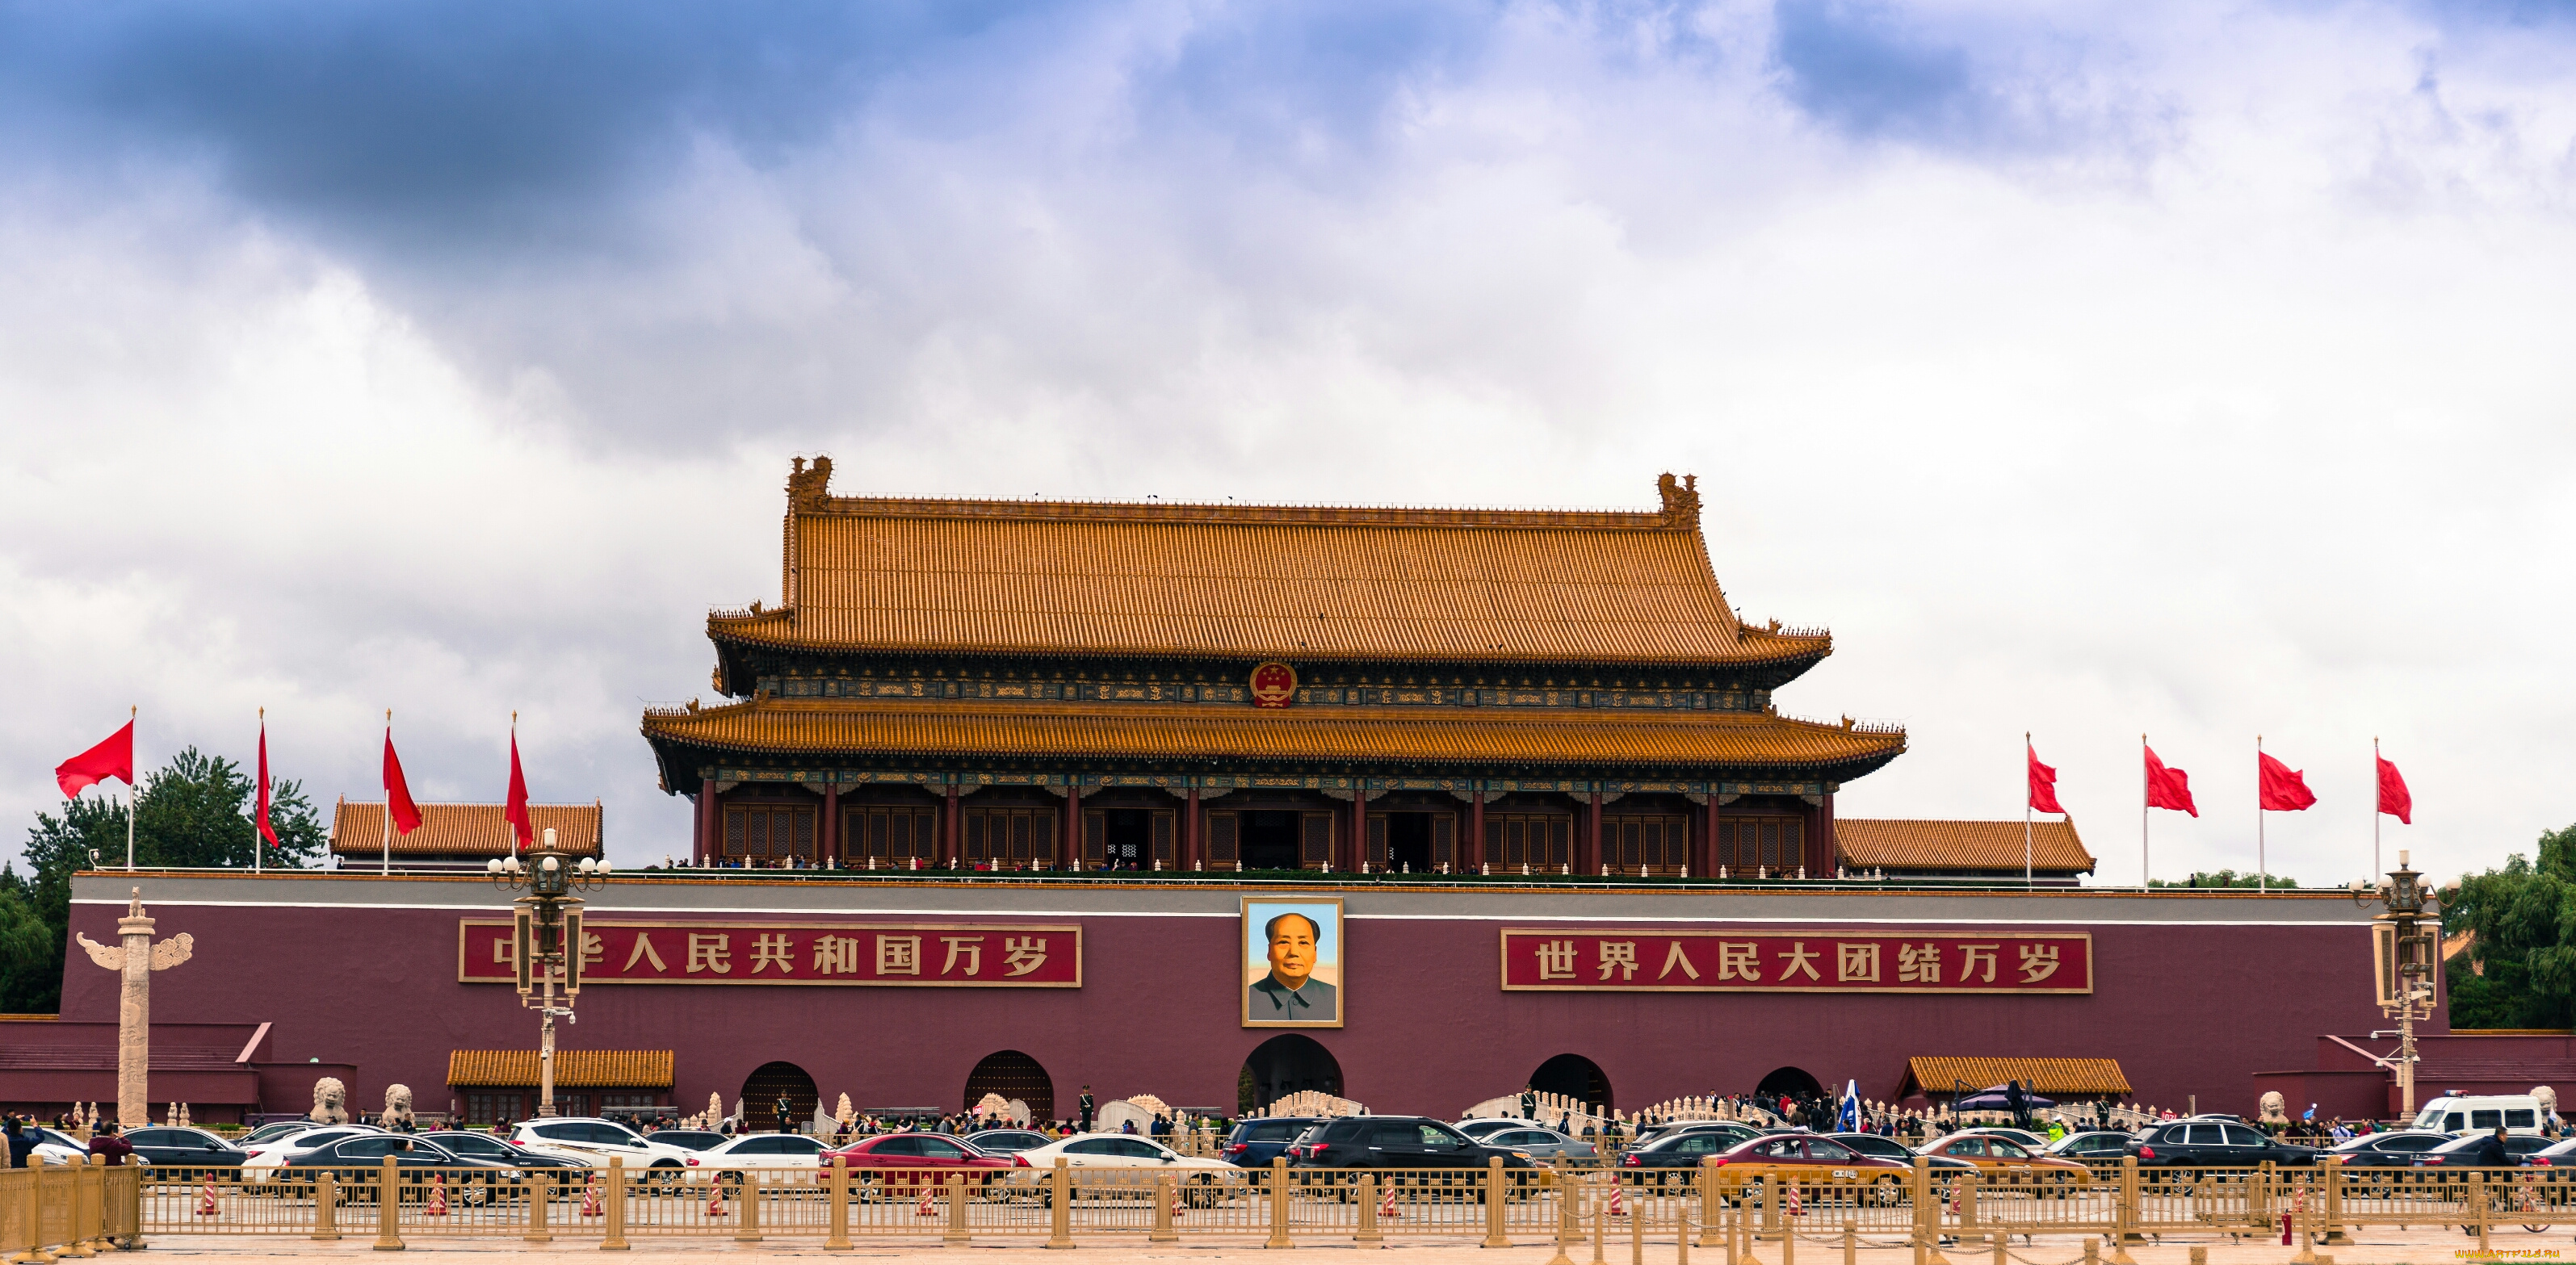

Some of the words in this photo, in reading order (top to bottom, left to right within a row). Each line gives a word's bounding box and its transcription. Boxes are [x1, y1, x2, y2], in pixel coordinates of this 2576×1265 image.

[1535, 940, 2061, 983] 世界人民大团结万岁
